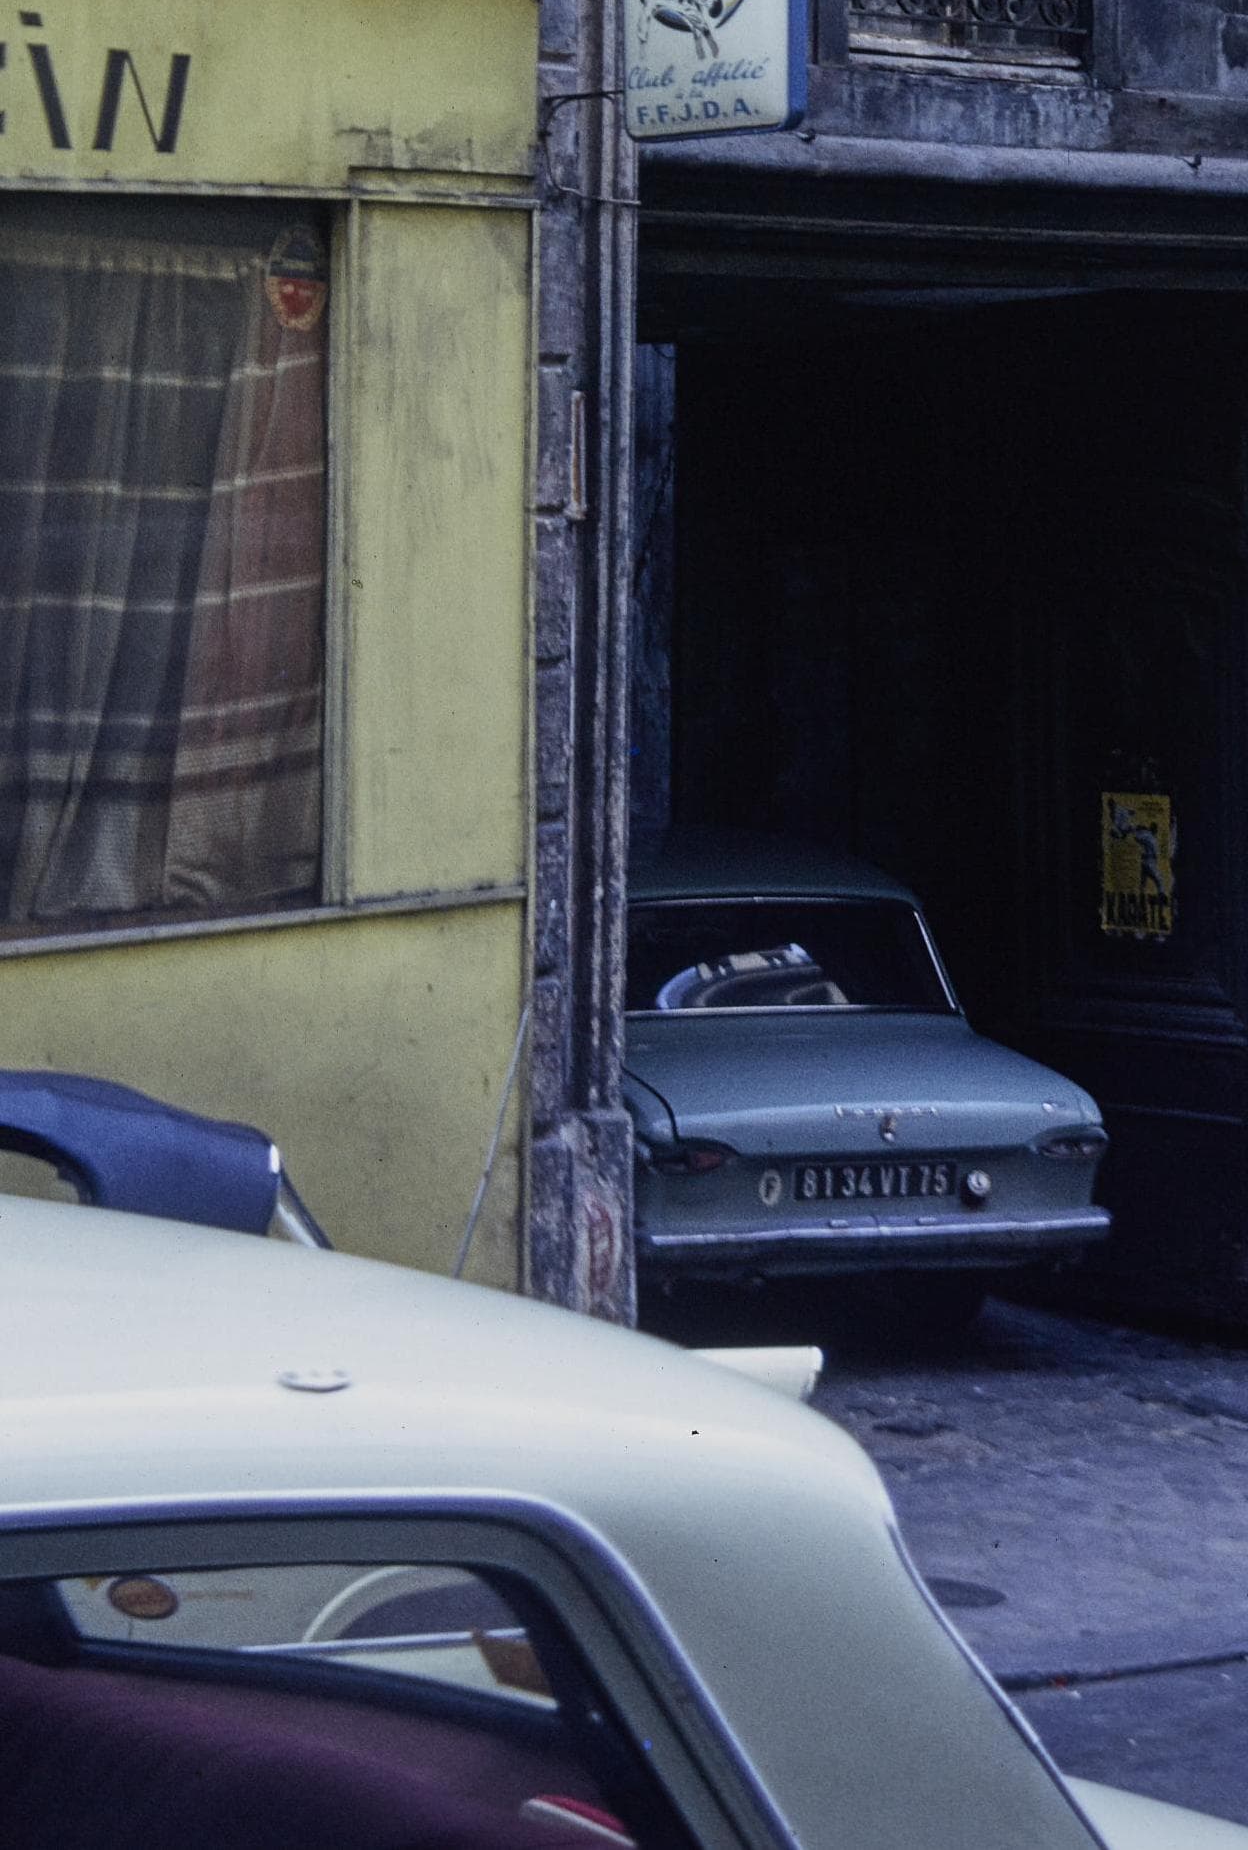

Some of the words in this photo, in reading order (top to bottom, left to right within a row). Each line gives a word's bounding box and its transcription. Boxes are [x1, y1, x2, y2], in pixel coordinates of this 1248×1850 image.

[626, 64, 674, 90] Club
[690, 56, 770, 89] affilié
[636, 97, 760, 125] F.F.J.D.A.
